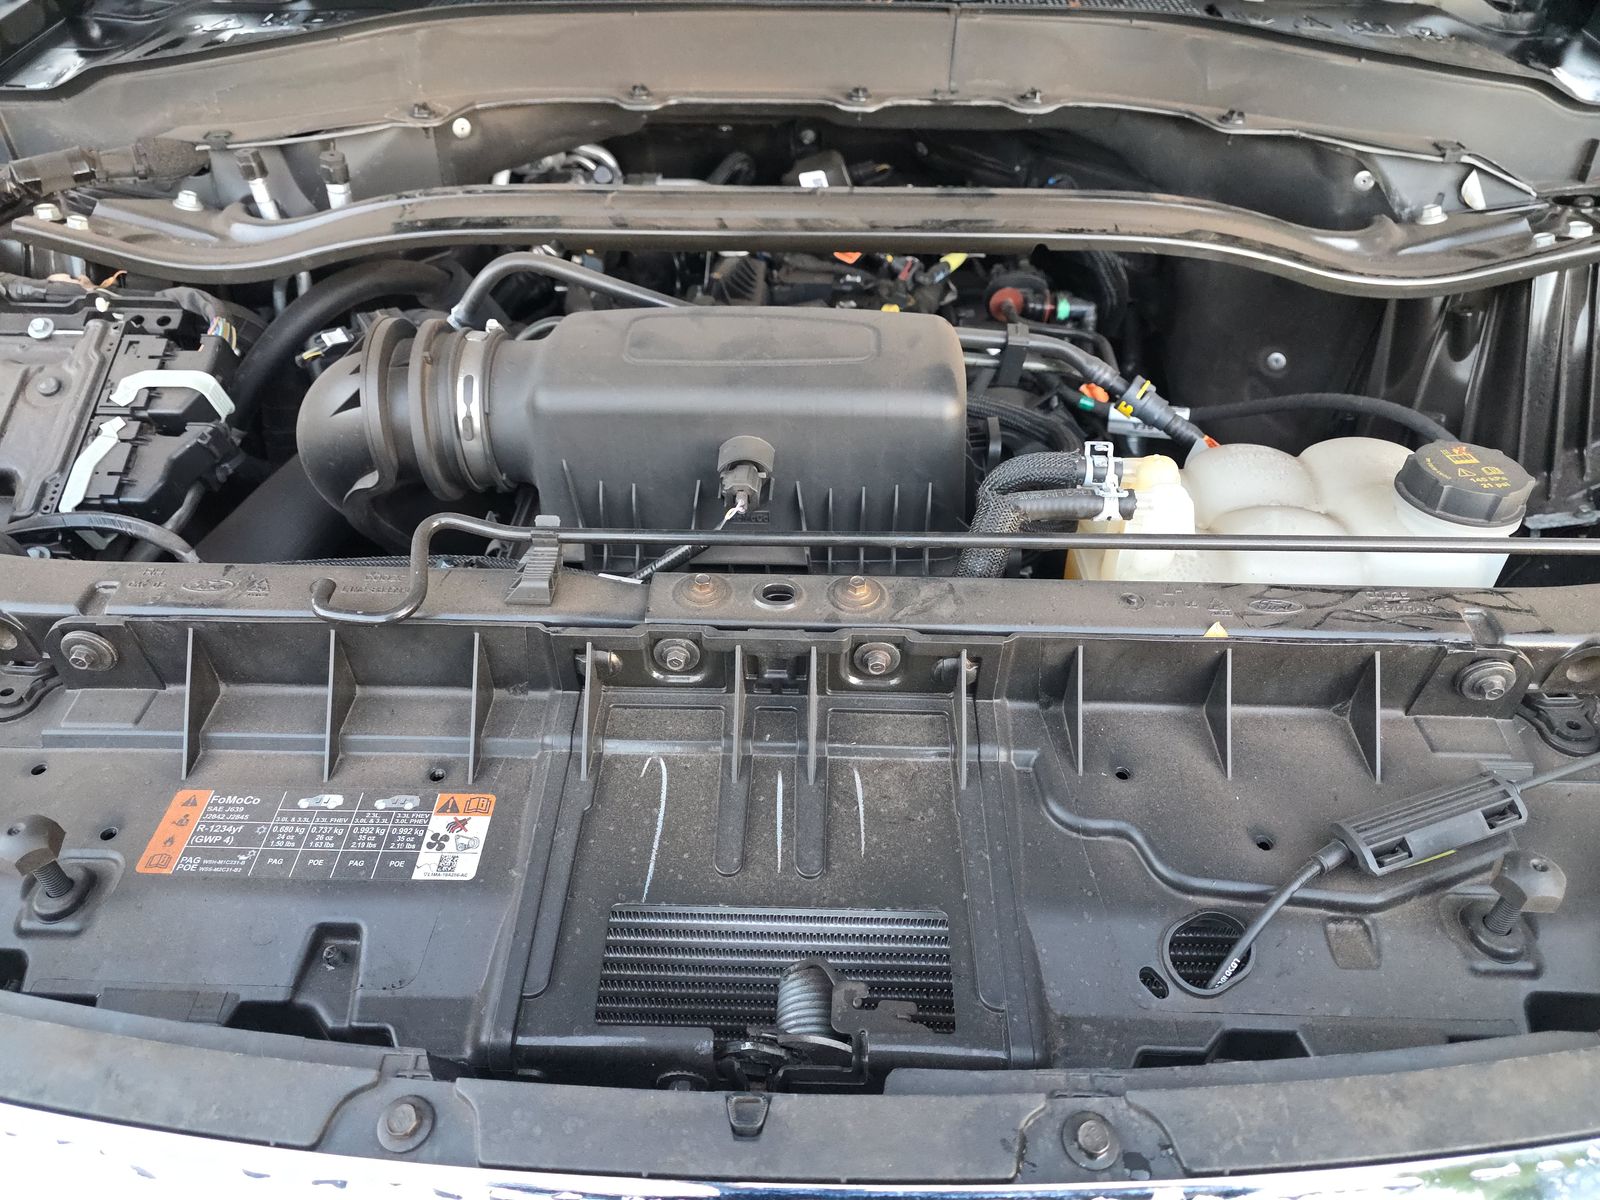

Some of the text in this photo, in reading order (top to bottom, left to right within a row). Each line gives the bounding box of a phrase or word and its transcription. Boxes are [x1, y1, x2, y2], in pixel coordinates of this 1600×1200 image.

[1255, 600, 1295, 612] Ford
[210, 795, 260, 805] FoMoCo
[196, 824, 243, 834] R-1234yf
[294, 826, 306, 834] kg
[334, 827, 344, 835] kg
[414, 828, 424, 836] kg
[190, 835, 234, 845] (GWP 4)
[176, 864, 198, 872] POE
